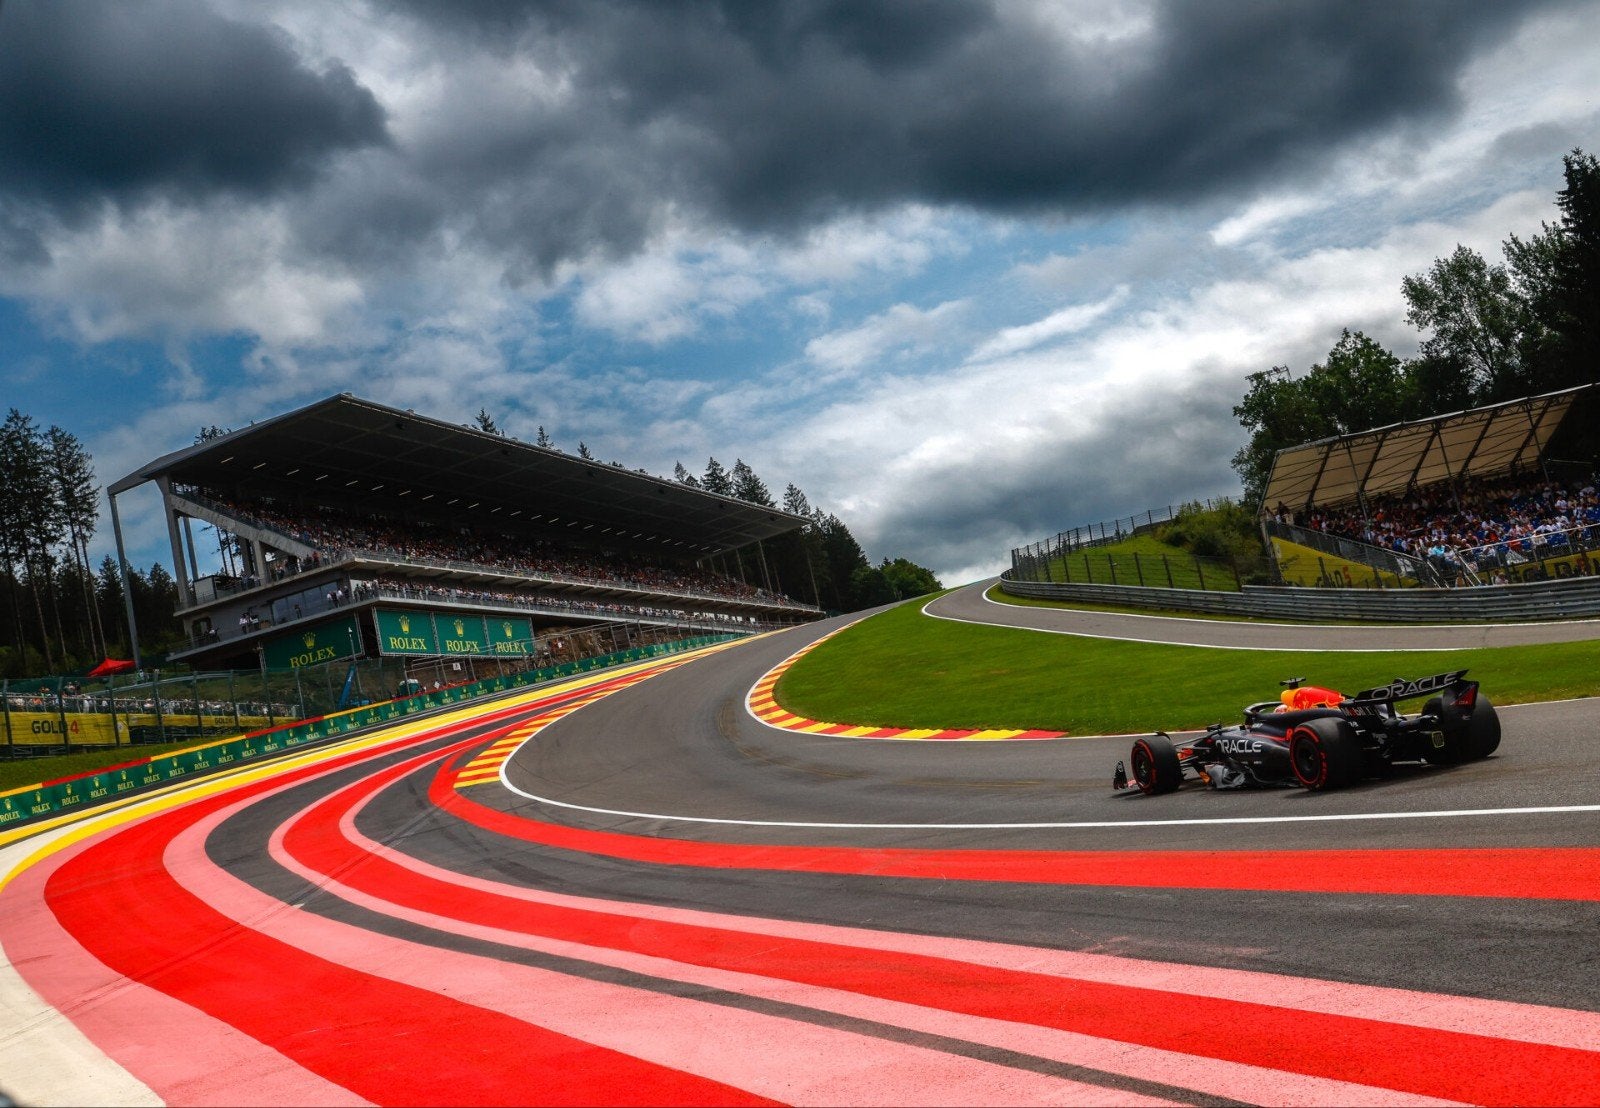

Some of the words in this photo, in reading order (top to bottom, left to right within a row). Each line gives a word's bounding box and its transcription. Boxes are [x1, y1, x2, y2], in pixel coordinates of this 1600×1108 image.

[389, 637, 427, 650] ROLEX
[446, 640, 480, 653] ROLEX
[290, 646, 336, 669] ROLEX
[1371, 673, 1459, 699] ORACLE
[32, 720, 68, 734] GOLD
[70, 720, 79, 734] 4
[264, 743, 278, 752] ROLEX
[1215, 739, 1263, 753] ORACLE
[242, 748, 257, 758] ROLEX
[194, 760, 210, 771] ROLEX
[218, 755, 234, 765] ROLEX
[168, 766, 185, 777] ROLEX
[143, 773, 160, 784] ROLEX
[117, 780, 134, 791] ROLEX
[90, 787, 108, 799] ROLEX
[61, 794, 80, 806] ROLEX
[31, 802, 50, 815] ROLEX
[0, 810, 21, 823] ROLEX
